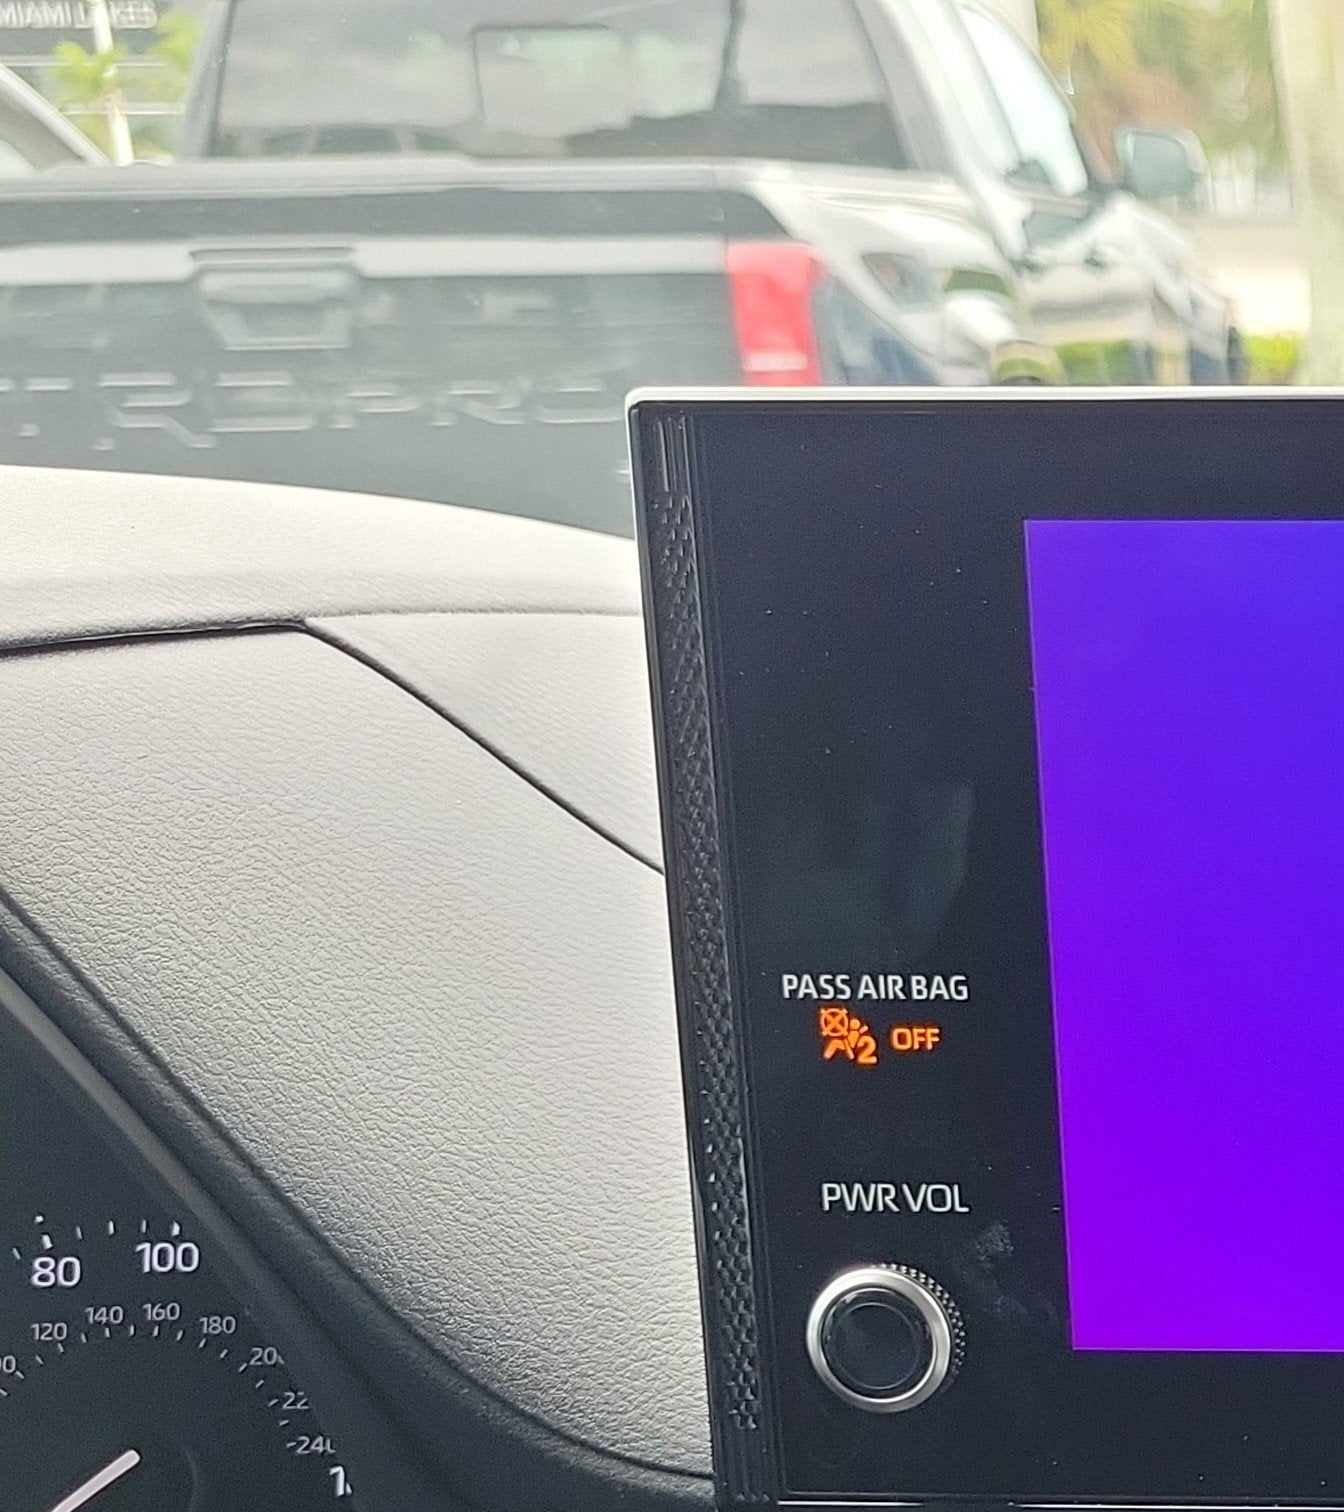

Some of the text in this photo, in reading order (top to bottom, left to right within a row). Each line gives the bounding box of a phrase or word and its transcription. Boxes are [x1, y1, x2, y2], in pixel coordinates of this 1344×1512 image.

[74, 0, 157, 28] LKES
[782, 974, 969, 1000] PASS AIR BAG
[892, 1027, 941, 1050] OFF
[821, 1183, 970, 1212] PWR VOL
[136, 1242, 200, 1273] 100
[31, 1256, 82, 1288] 80
[85, 1305, 124, 1325] 140
[143, 1302, 181, 1321] 160
[31, 1322, 67, 1341] 120
[200, 1316, 236, 1335] 180
[249, 1346, 285, 1366] 20
